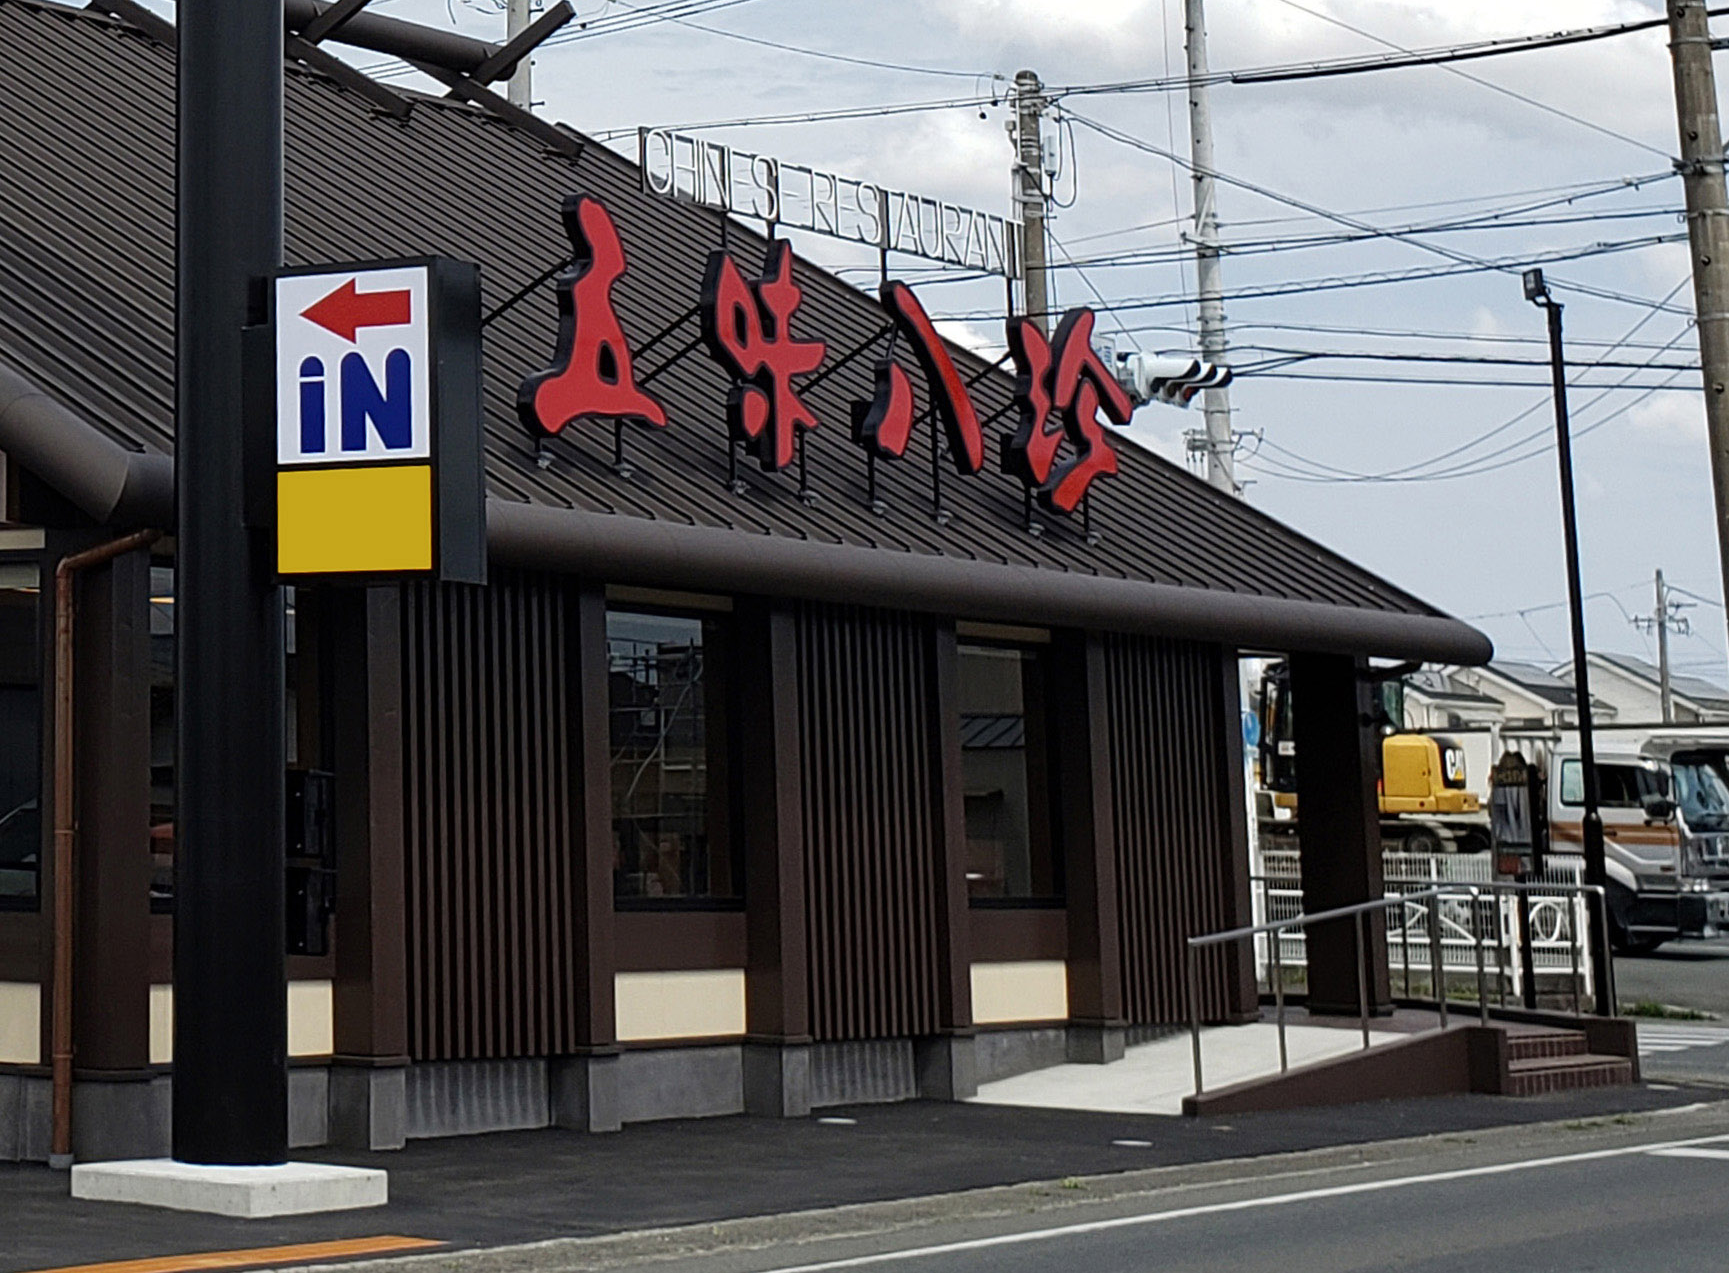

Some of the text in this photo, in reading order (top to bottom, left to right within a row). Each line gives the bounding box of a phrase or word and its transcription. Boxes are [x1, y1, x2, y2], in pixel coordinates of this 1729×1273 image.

[646, 130, 1025, 280] CHINESE RESTAURANT
[527, 194, 1133, 514] 五味八珍
